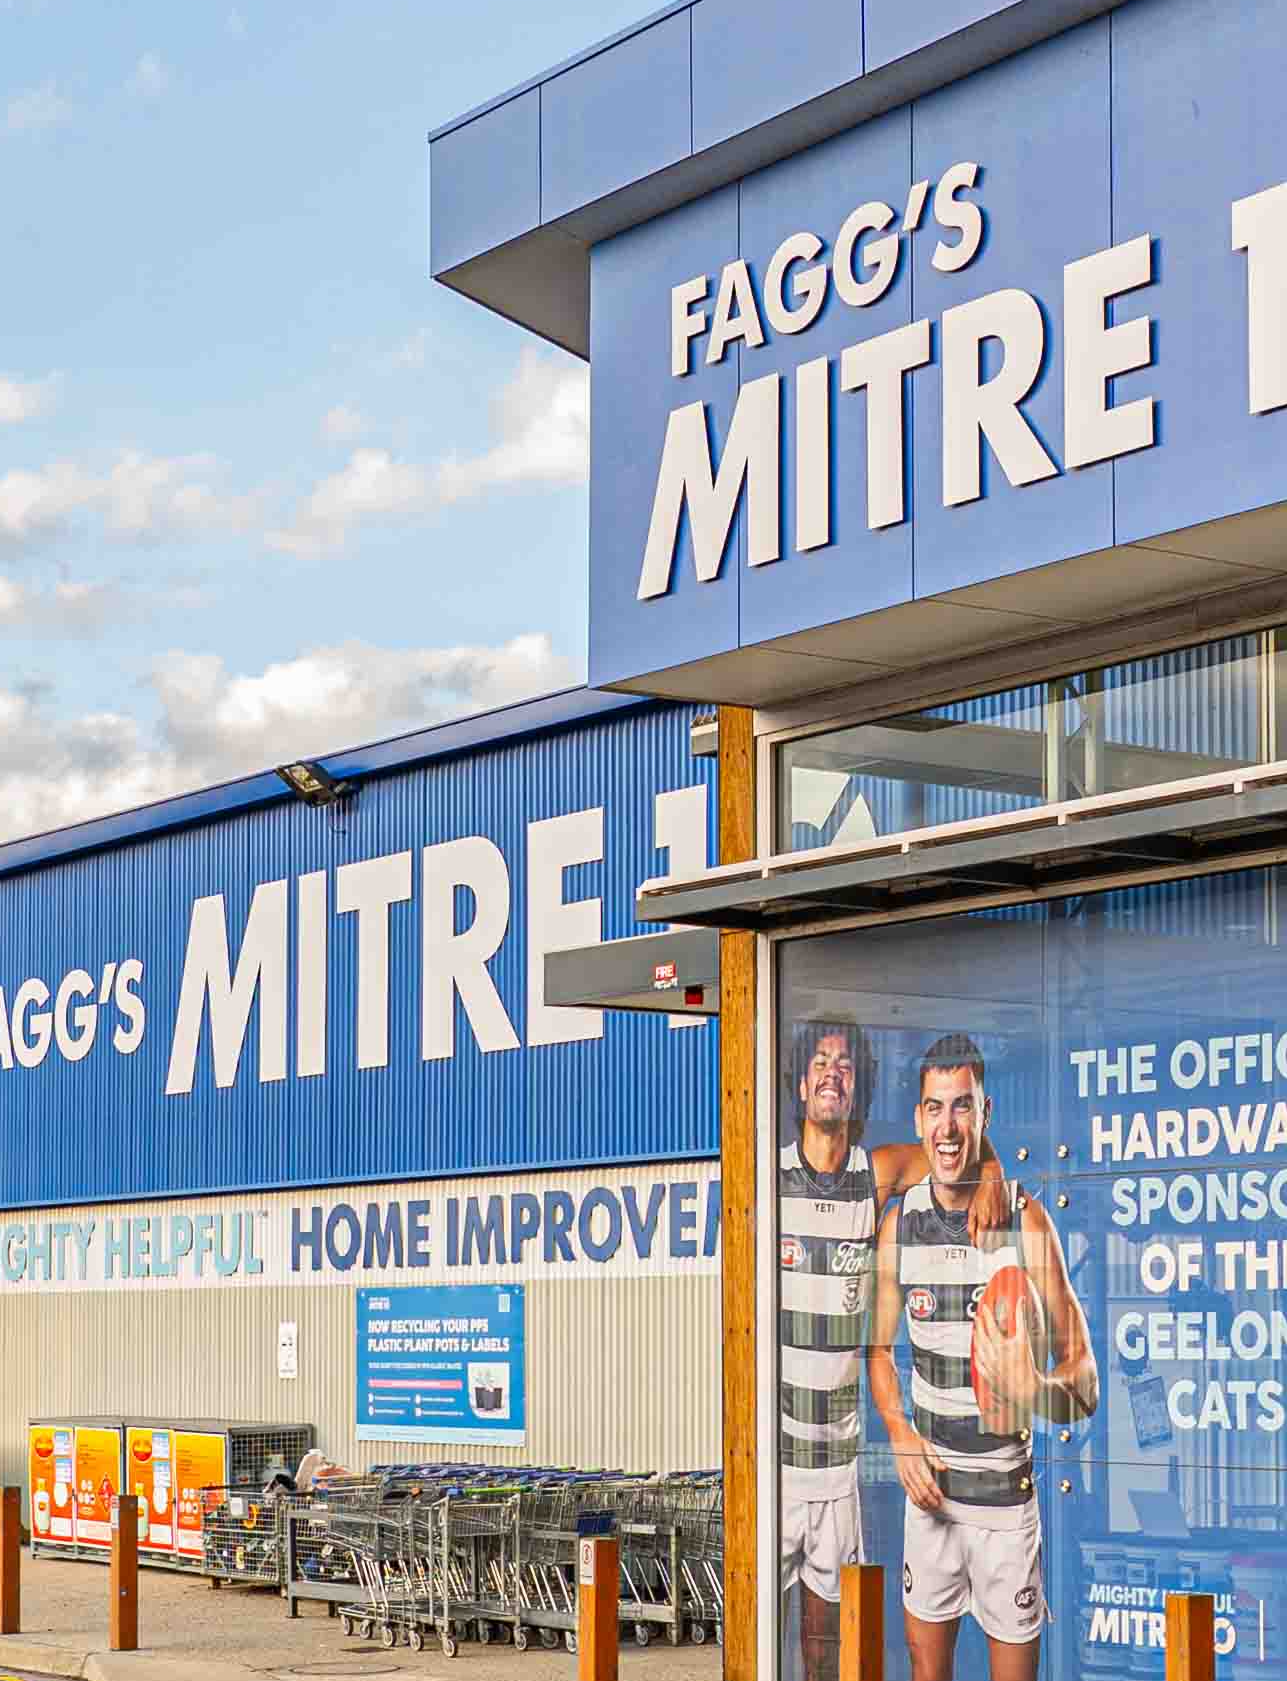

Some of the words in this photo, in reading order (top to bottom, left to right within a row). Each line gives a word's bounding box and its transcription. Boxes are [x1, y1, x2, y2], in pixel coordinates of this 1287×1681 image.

[671, 161, 985, 377] FAGG'S
[637, 232, 1157, 601] MITRE
[164, 806, 605, 1096] MITRE
[655, 965, 674, 979] FIRE
[1070, 1044, 1157, 1097] THE
[104, 1210, 264, 1279] HELPFUL
[291, 1199, 430, 1272] HOME
[447, 1180, 720, 1266] IMPROVE
[814, 1202, 835, 1213] YETI
[944, 1248, 967, 1259] YETI
[1140, 1242, 1204, 1293] OF
[368, 1320, 389, 1334] NOW
[391, 1319, 440, 1334] RECYCLING
[442, 1318, 468, 1333] YOUR
[368, 1338, 402, 1353] PLASTIC
[404, 1338, 433, 1353] PLANT
[435, 1338, 459, 1353] POTS
[460, 1339, 469, 1352] &
[471, 1337, 510, 1353] LABELS
[1168, 1379, 1285, 1431] CATS
[1089, 1584, 1158, 1608] MIGHTY
[1089, 1607, 1167, 1649] MITR
[1214, 1617, 1237, 1655] 0
